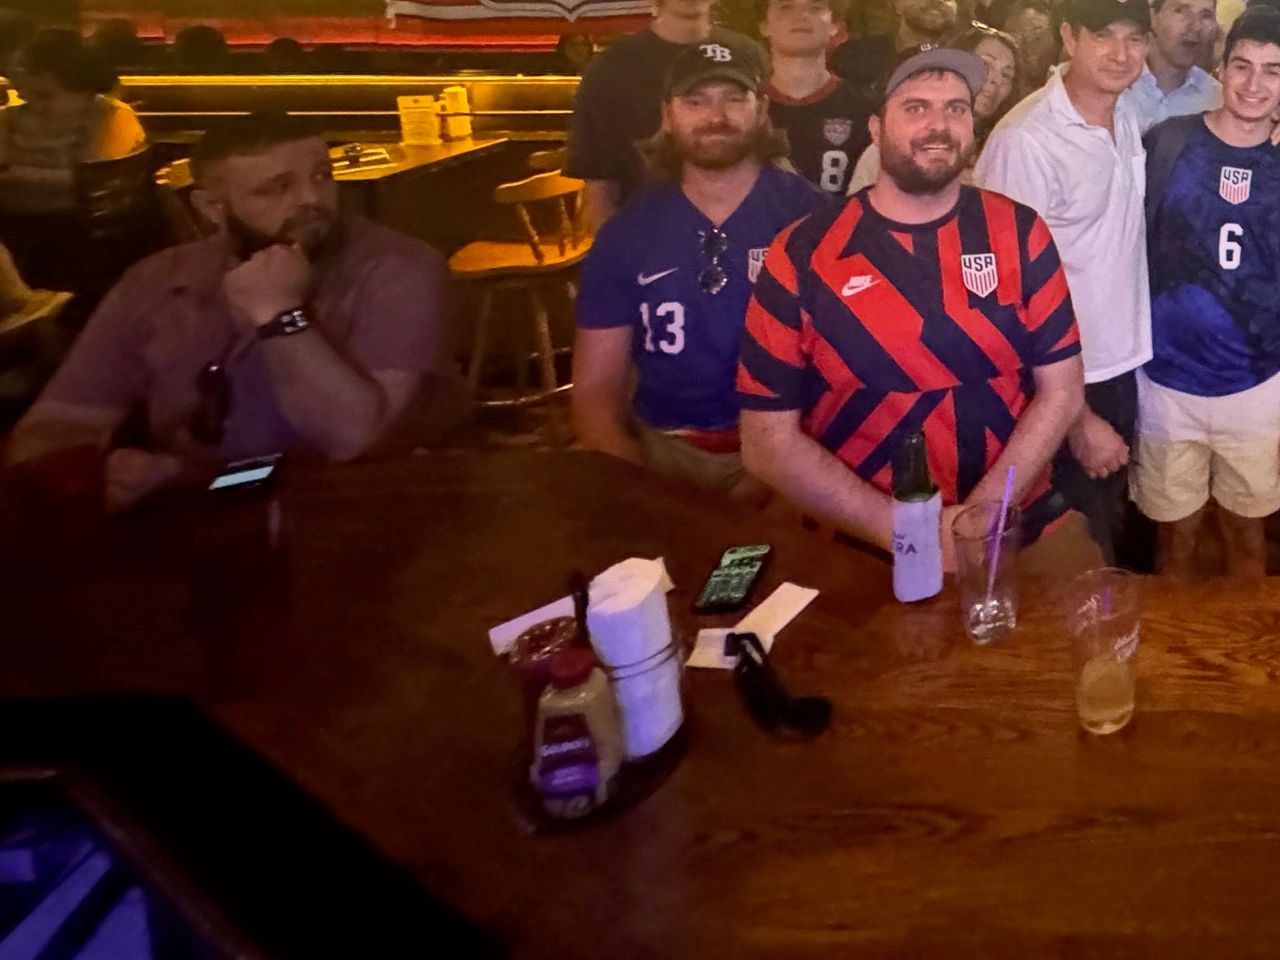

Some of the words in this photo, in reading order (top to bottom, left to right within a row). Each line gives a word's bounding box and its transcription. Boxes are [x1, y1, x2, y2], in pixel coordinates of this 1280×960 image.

[821, 150, 848, 192] 8
[1223, 168, 1249, 185] USA
[963, 254, 994, 271] USA
[1219, 222, 1244, 270] 6
[639, 301, 685, 355] 13
